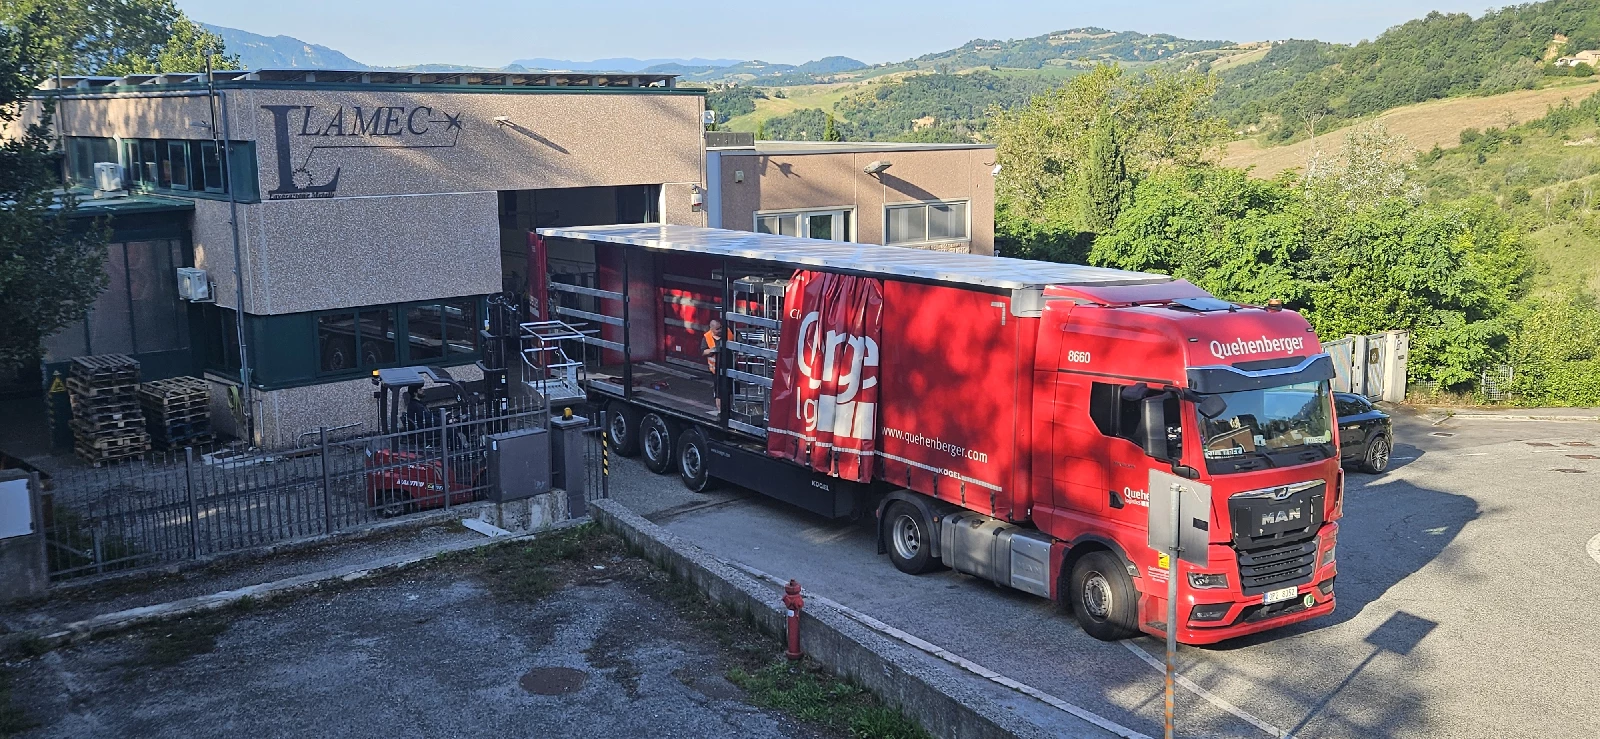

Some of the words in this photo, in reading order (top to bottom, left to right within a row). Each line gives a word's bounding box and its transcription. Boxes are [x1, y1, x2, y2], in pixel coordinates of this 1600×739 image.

[298, 106, 432, 137] LAMEC
[1067, 350, 1091, 364] 8660
[1209, 334, 1304, 360] Quehenberger
[881, 426, 988, 464] www.quehenberger.com
[1261, 507, 1301, 526] MAN
